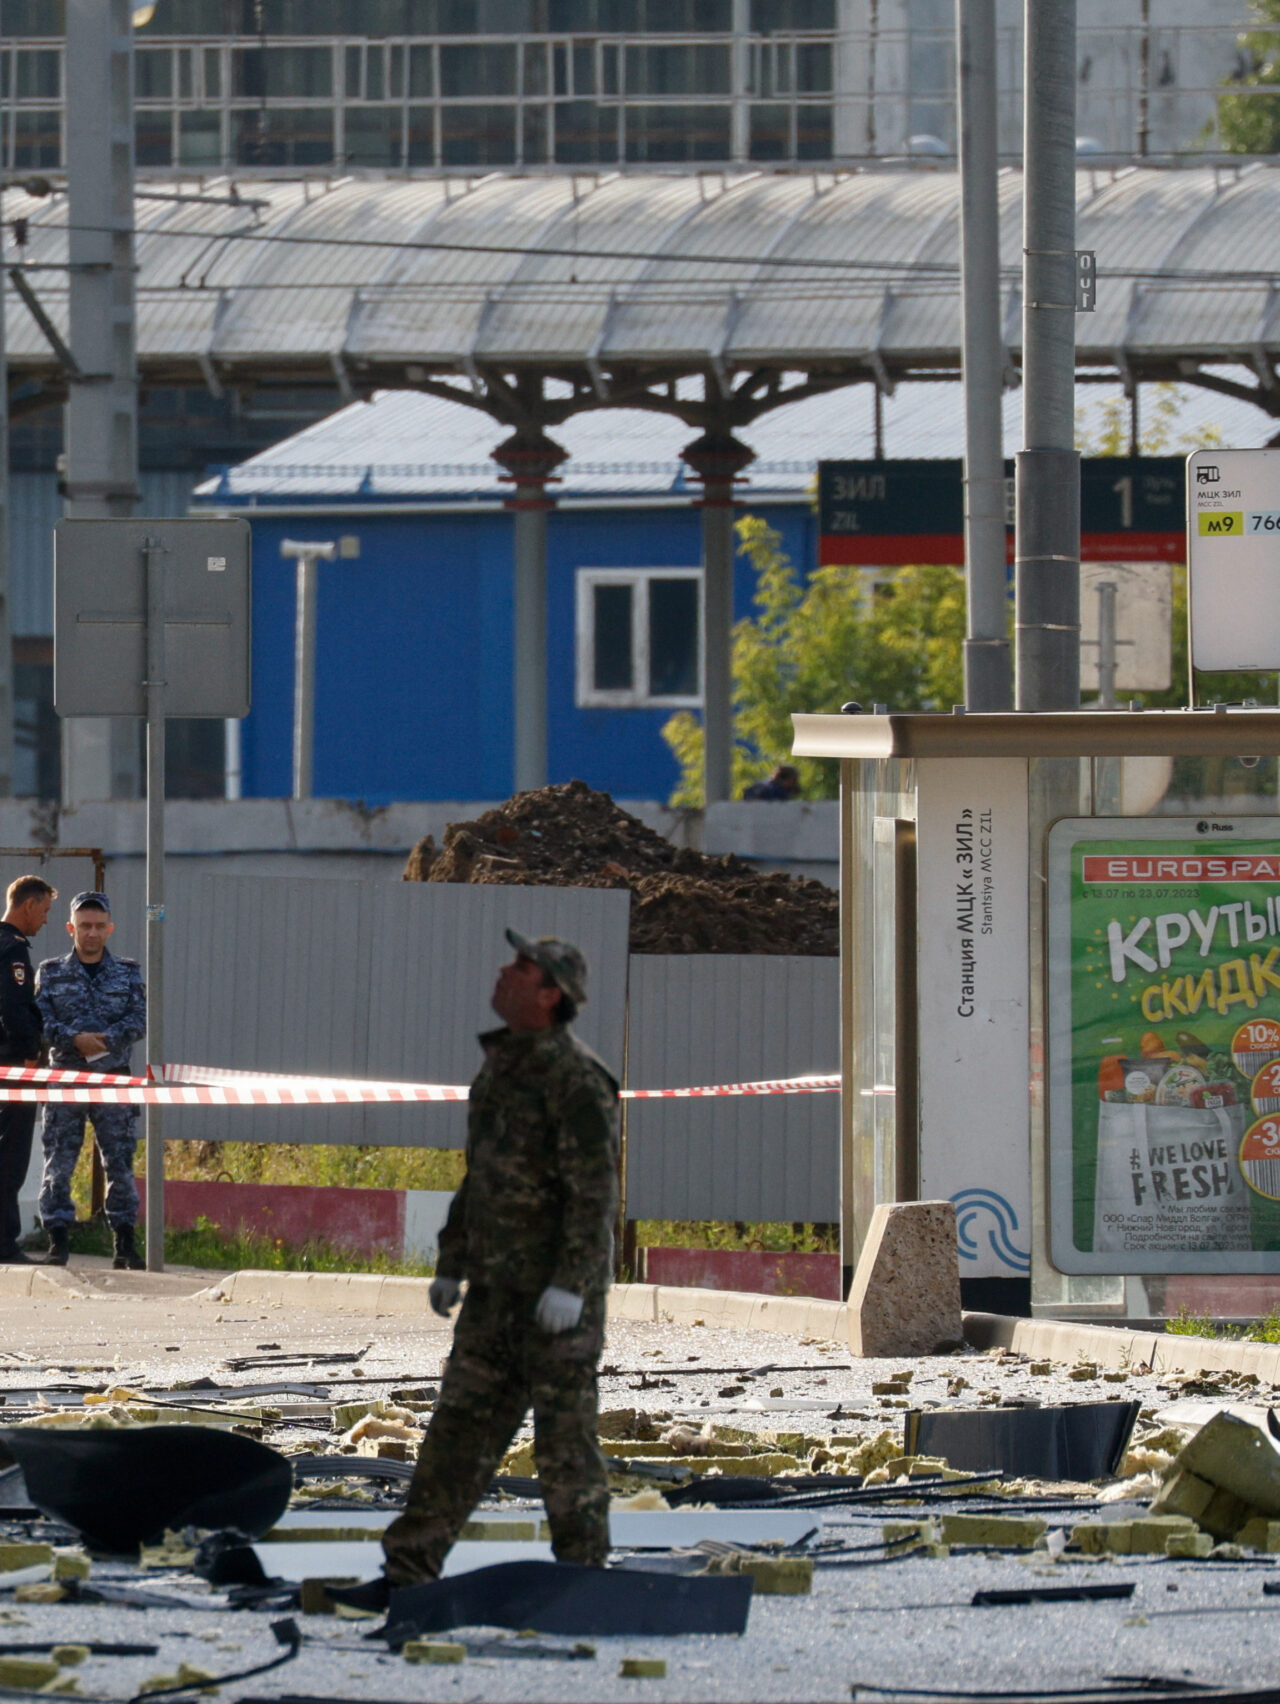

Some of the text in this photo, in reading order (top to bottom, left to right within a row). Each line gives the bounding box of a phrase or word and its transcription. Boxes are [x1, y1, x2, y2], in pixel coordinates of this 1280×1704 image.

[832, 473, 886, 501] ЗИЛ
[1112, 476, 1133, 529] 1
[1197, 489, 1242, 500] МЦК ЗИЛ
[1211, 823, 1234, 832] Russ
[980, 807, 996, 935] Stantsiya MCC ZIL
[1107, 860, 1280, 878] EUROSPA
[956, 882, 977, 934] МЦК
[957, 938, 977, 1018] Станция
[1180, 1138, 1228, 1164] LOVE
[1131, 1161, 1235, 1207] FRESH
[1102, 1213, 1125, 1223] ООО
